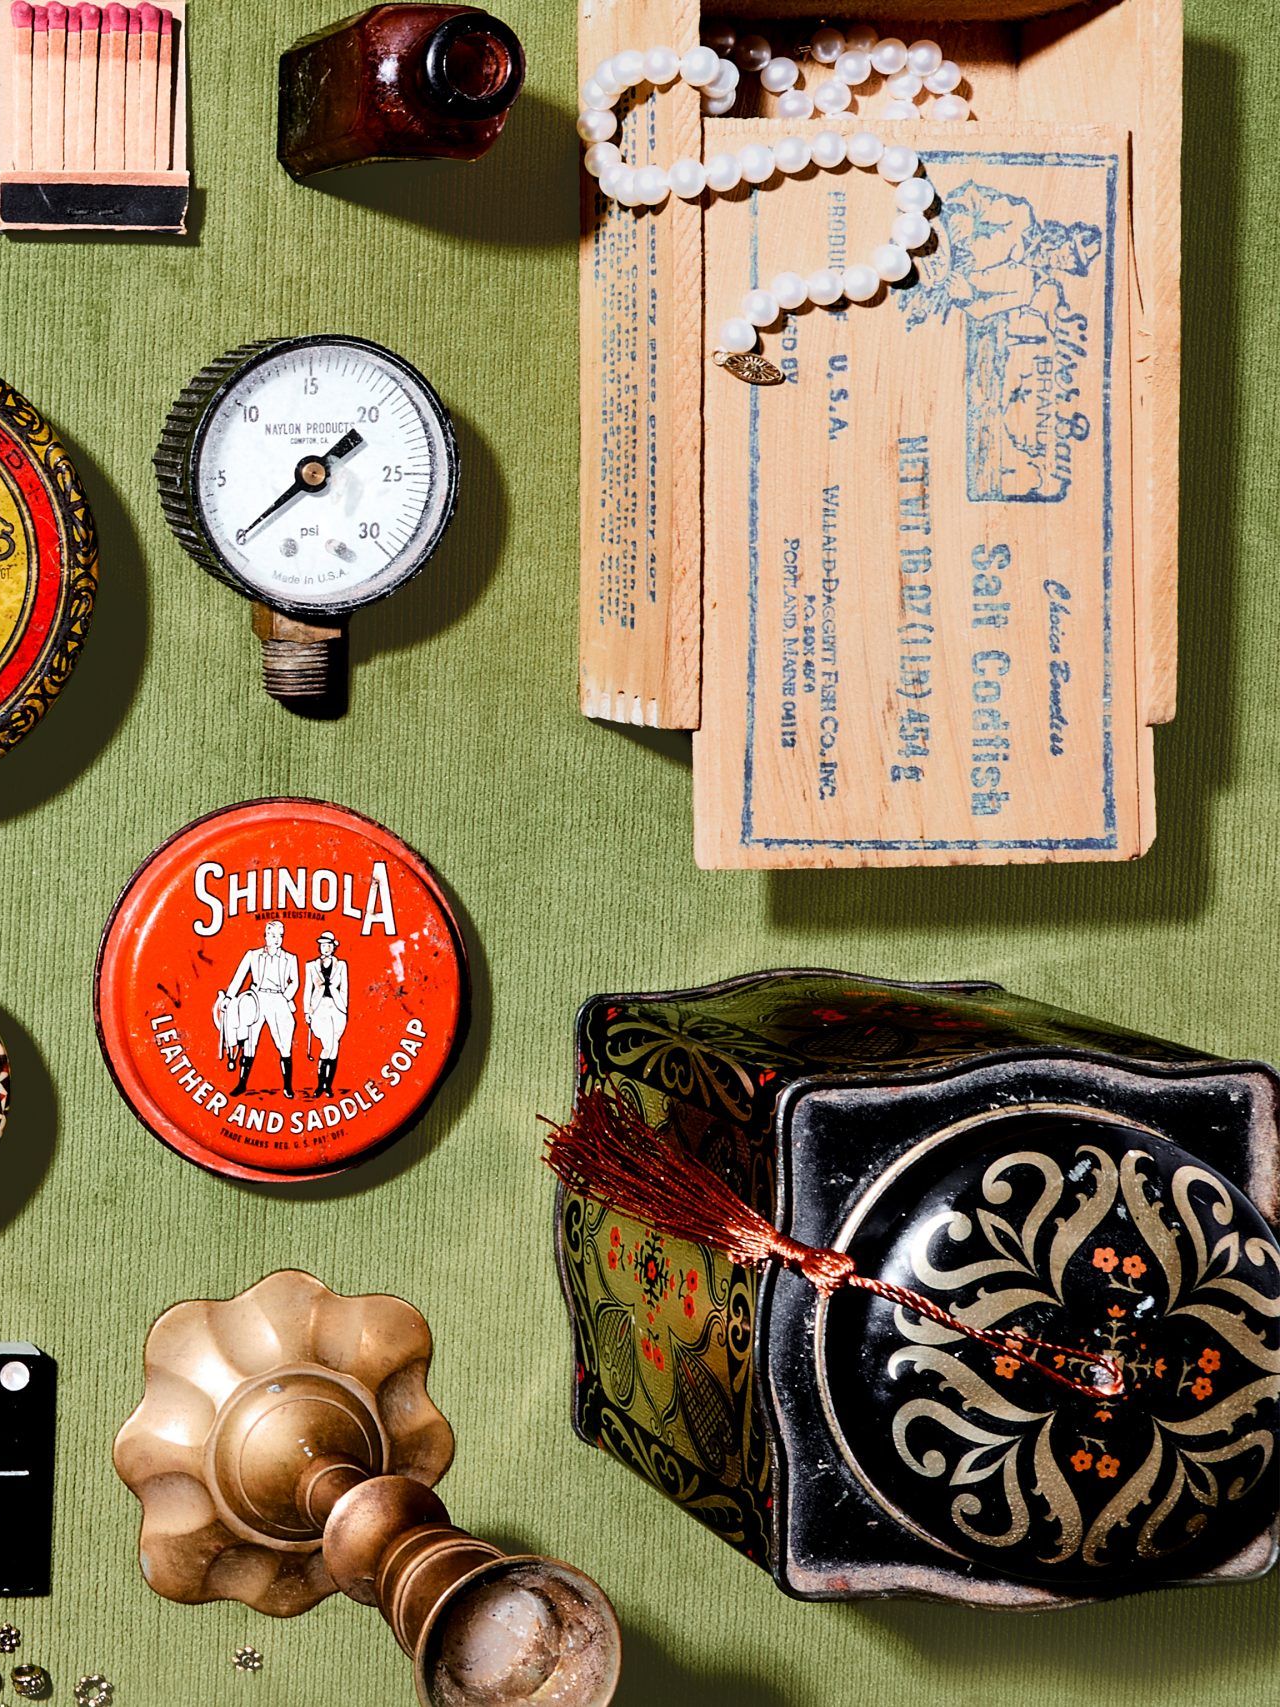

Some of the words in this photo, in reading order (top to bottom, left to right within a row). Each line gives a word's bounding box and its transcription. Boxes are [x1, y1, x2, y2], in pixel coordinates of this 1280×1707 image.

[648, 287, 658, 326] dry
[649, 338, 658, 402] place
[781, 357, 799, 385] BY
[303, 378, 319, 396] 15
[242, 405, 259, 423] 10
[356, 406, 380, 424] 20
[265, 422, 301, 436] NAYLON
[382, 465, 403, 483] 25
[897, 435, 930, 487] NET
[217, 469, 227, 488] 5
[648, 414, 658, 540] preferably
[898, 493, 932, 535] WT
[236, 528, 247, 546] 0
[300, 527, 320, 538] psi
[358, 522, 380, 540] 30
[899, 546, 932, 574] 16
[273, 570, 301, 585] Made
[317, 568, 350, 584] U.S.A.
[970, 543, 1011, 630] Salt
[900, 584, 933, 616] OZ
[1042, 579, 1072, 655] Choice
[821, 671, 839, 713] FISH
[896, 708, 931, 759] 454
[970, 649, 1012, 817] Codfish
[192, 860, 398, 937] SHINOLA
[255, 911, 280, 921] MARCA
[282, 911, 326, 921] REGISTRADA
[150, 1013, 230, 1118] LEATHER
[227, 1103, 284, 1134] AND
[290, 1079, 387, 1134] SADDLE
[381, 1017, 428, 1087] SOAP
[220, 1127, 241, 1143] TRADE
